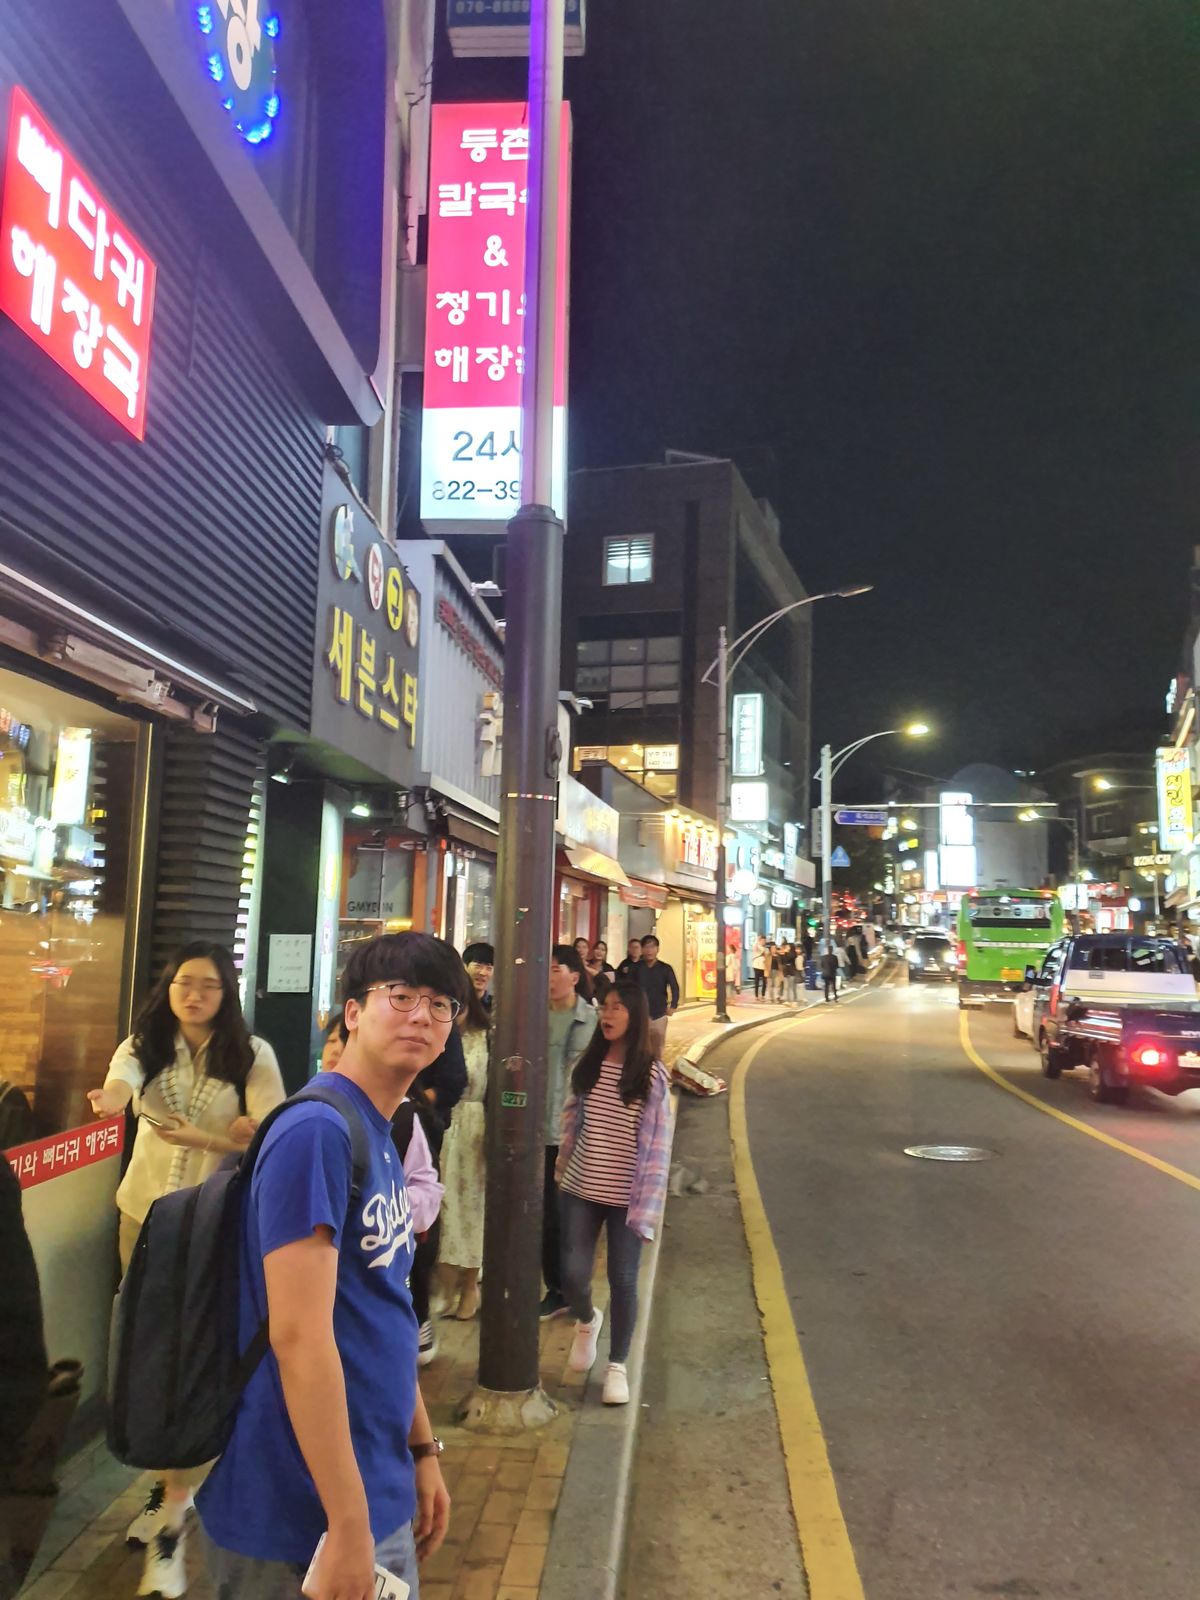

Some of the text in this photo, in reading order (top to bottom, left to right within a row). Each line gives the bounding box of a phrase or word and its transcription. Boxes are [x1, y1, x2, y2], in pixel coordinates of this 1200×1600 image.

[460, 127, 529, 163] 등촌
[438, 181, 528, 217] 칼국
[483, 235, 509, 267] &
[11, 224, 140, 419] 해장국
[435, 289, 527, 325] 청기
[434, 345, 525, 382] 해장
[327, 606, 417, 748] 세븐스타
[9, 1125, 119, 1178] 기와 뼈다귀 해장국
